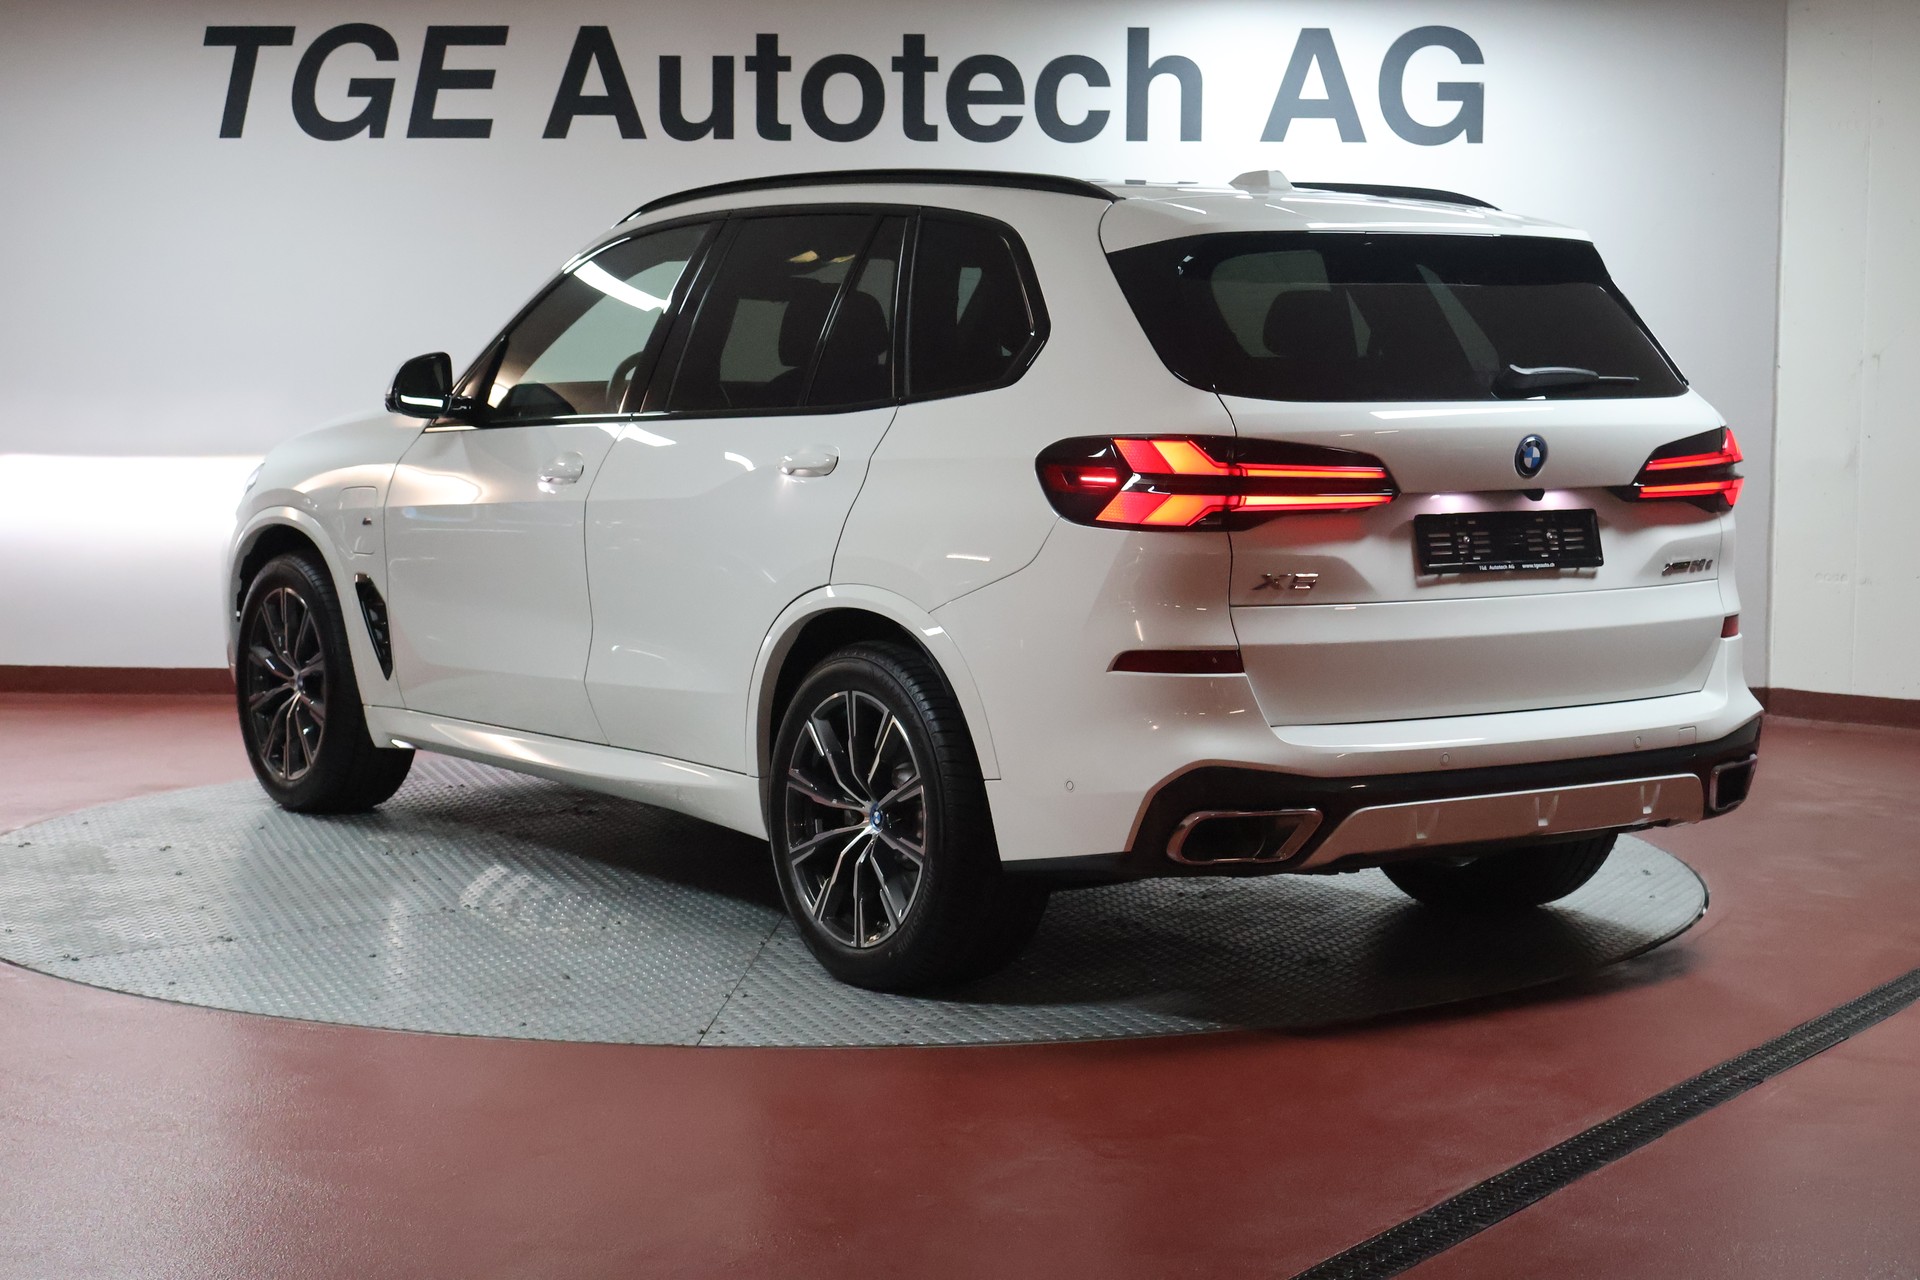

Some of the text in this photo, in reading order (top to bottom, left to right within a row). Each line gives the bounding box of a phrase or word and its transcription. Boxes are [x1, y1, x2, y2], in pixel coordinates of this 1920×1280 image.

[203, 24, 1485, 145] TGE Autotech AG
